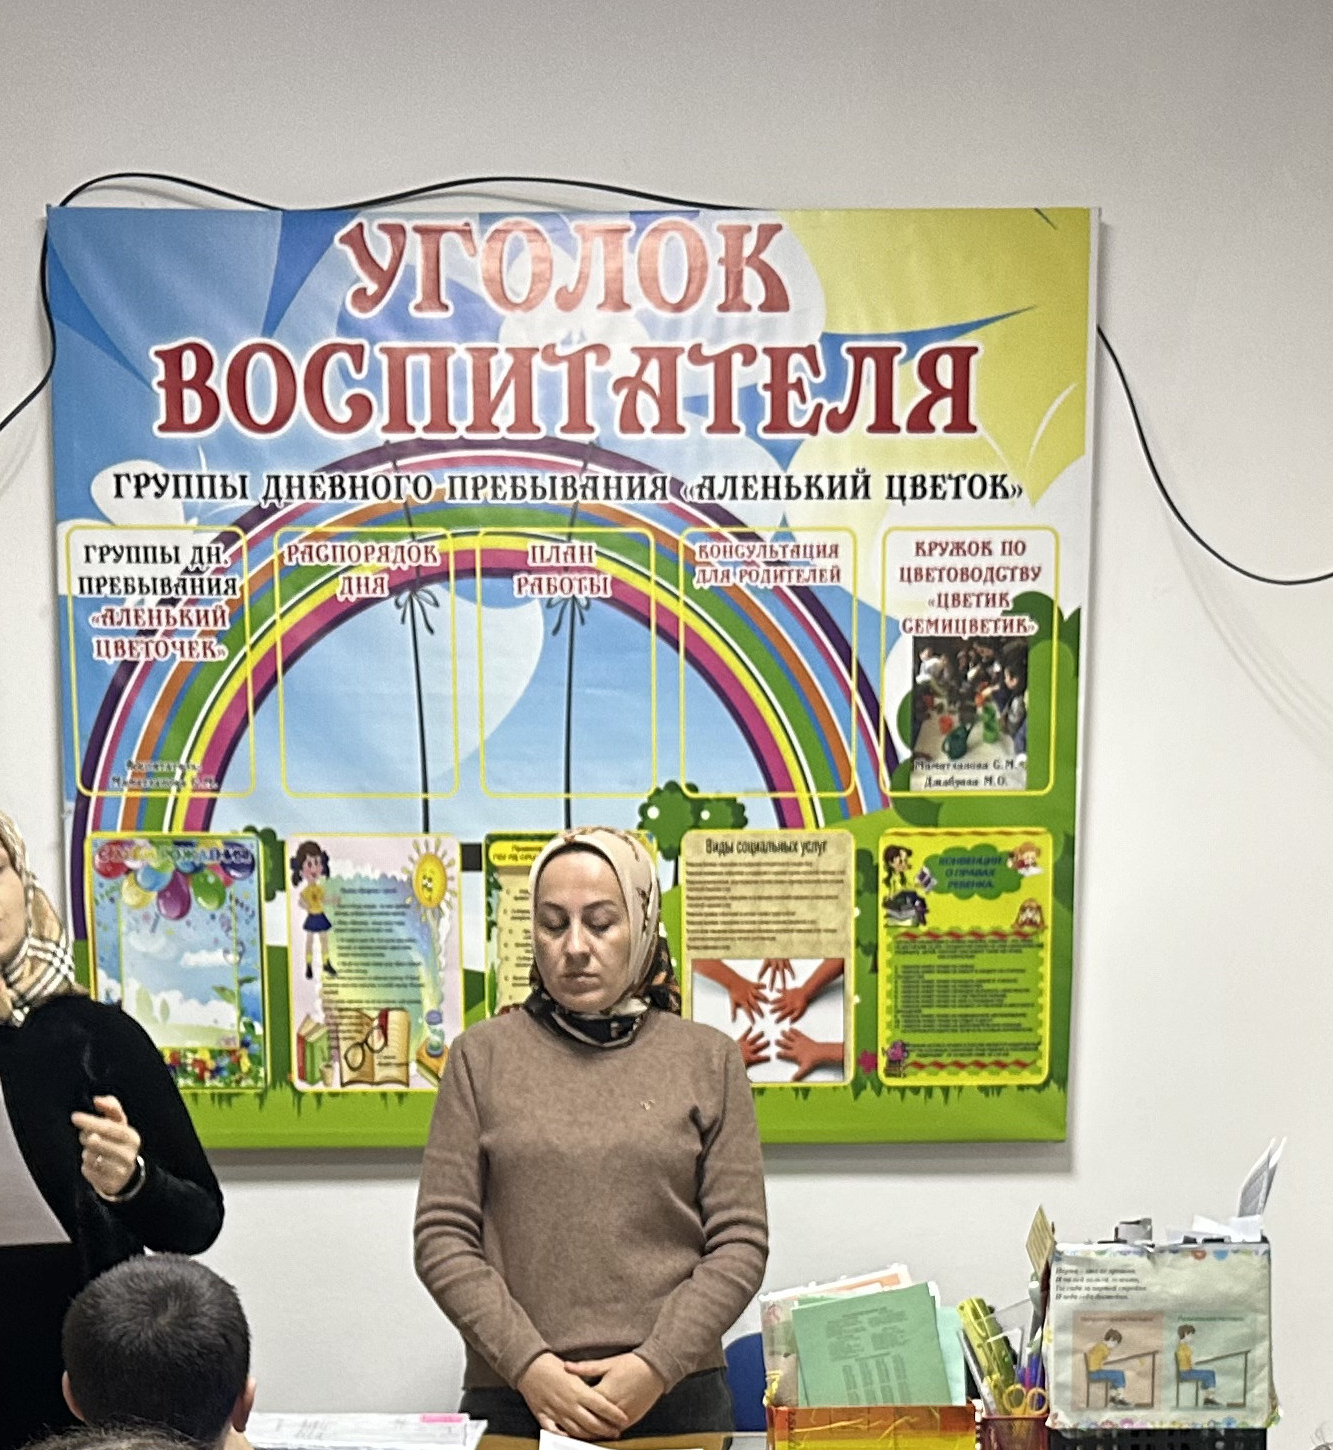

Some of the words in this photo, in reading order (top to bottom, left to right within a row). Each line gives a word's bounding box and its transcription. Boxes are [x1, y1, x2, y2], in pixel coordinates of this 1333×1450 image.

[339, 219, 789, 314] УГОЛОК
[153, 342, 978, 436] ВОСПИТАТЕЛЯ
[114, 472, 248, 502] ГРУППЫ
[262, 472, 433, 504] ДНЕВНОГО
[447, 472, 668, 504] ПРЕБЫВАНИЯ
[680, 468, 871, 503] «АЛЕНЬКИЙ
[885, 472, 1024, 507] ЦВЕТОК»
[84, 545, 180, 565] ГРУППЫ
[191, 545, 229, 569] ДН.
[286, 545, 438, 567] РАСПОРЯДОК
[530, 545, 594, 564] ПЛАН
[698, 543, 839, 561] КОНСУЛЬТАЦИЯ
[915, 541, 993, 558] КРУЖОК
[1002, 541, 1027, 557] ПО
[696, 568, 732, 586] ДЛЯ
[740, 564, 842, 585] РОДИТЕЛЕЙ
[900, 566, 1042, 585] ЦВЕТОВОДСТВУ
[78, 576, 238, 596] ПРЕБЫВАНИЯ
[339, 576, 389, 598] ДНЯ
[517, 576, 610, 596] РАБОТЫ
[928, 592, 1010, 611] «ЦВЕТИК
[90, 605, 228, 629] «АЛЕНЬКИЙ
[902, 618, 1037, 636] СЕМИЦВЕТИК»
[94, 640, 227, 662] ЦВЕТОЧЕК»
[705, 838, 734, 856] Виды
[800, 839, 828, 857] услуг
